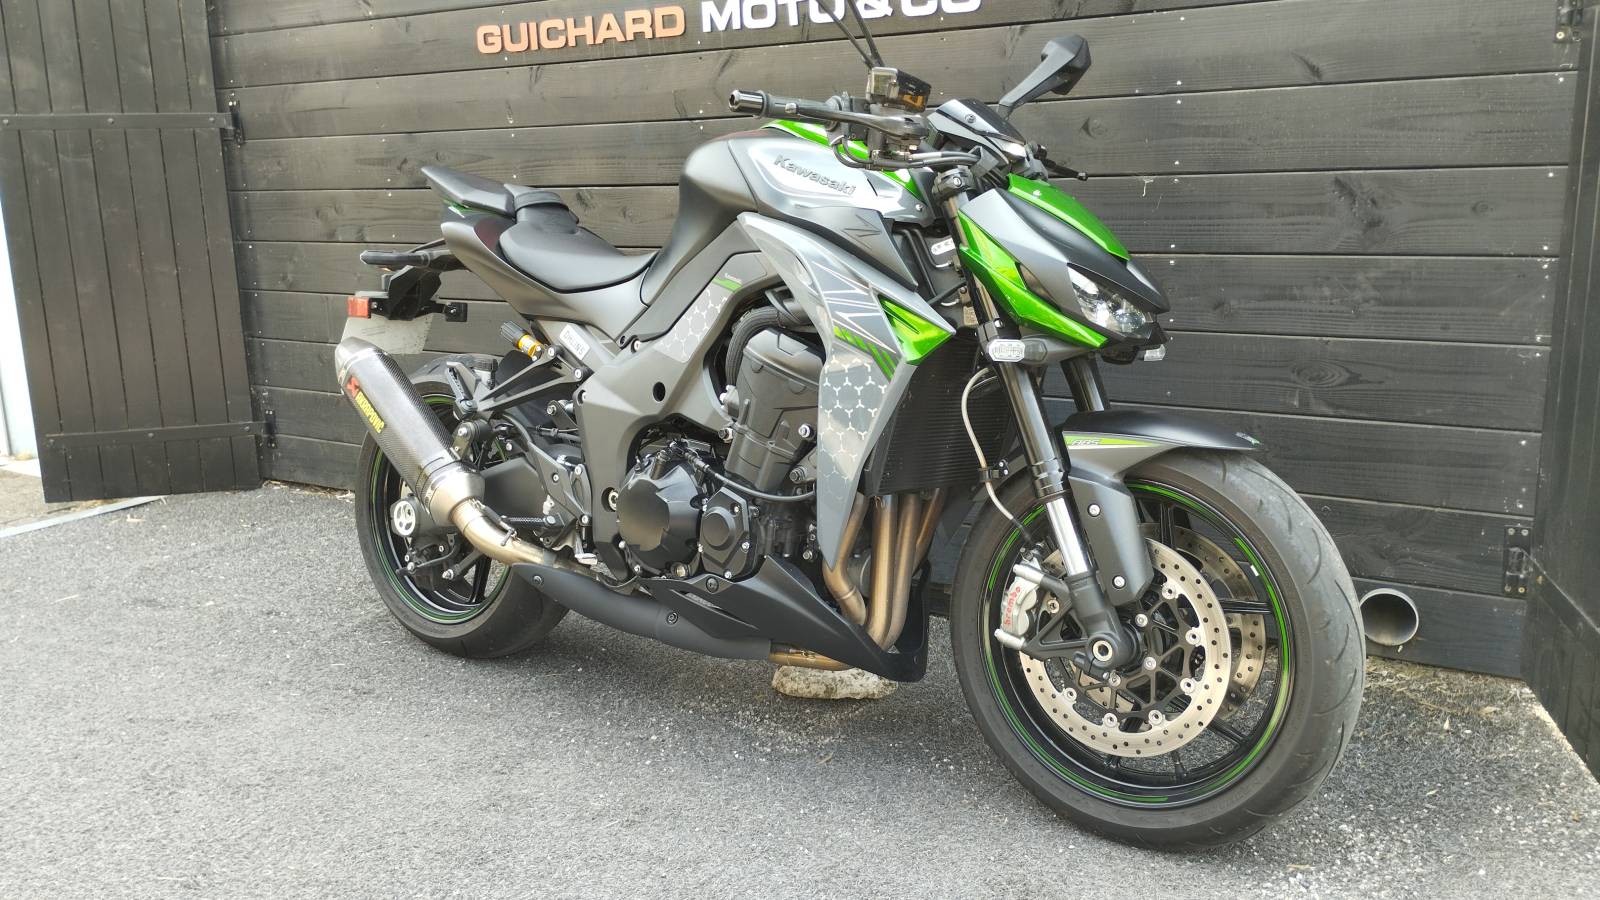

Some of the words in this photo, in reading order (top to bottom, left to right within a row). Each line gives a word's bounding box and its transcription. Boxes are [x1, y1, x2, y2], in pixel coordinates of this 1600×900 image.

[476, 6, 686, 54] GUICHARD
[773, 154, 856, 196] Kawasaki
[1004, 586, 1021, 625] brembo
